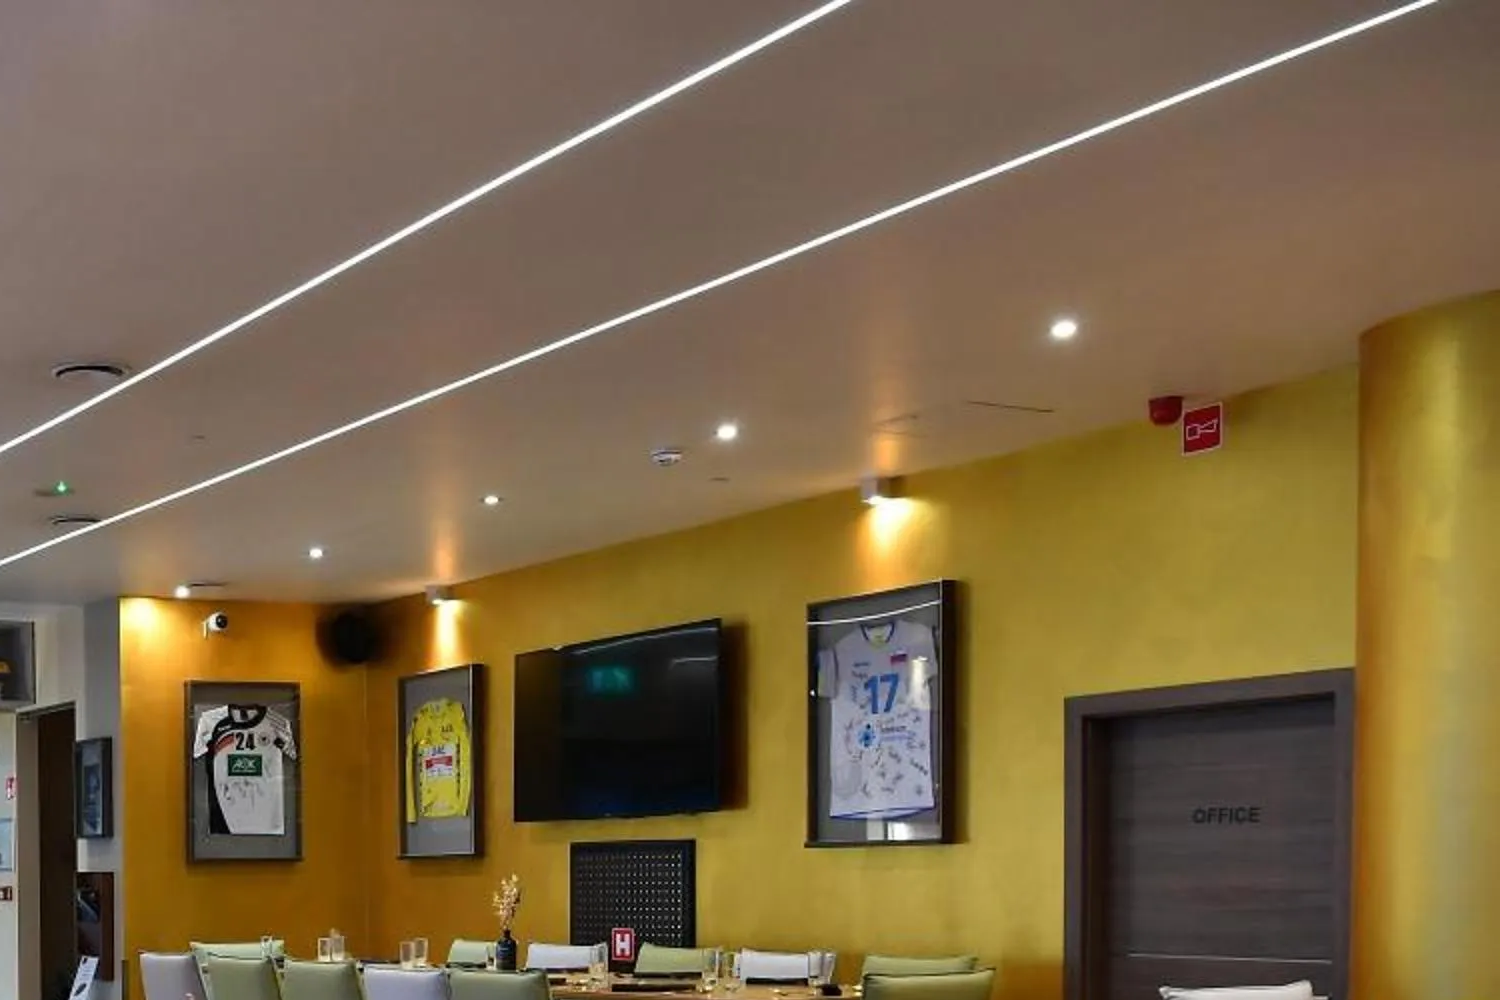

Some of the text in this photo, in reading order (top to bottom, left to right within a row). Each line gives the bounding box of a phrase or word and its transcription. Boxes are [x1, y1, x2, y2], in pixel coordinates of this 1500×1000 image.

[865, 674, 899, 714] 17
[235, 732, 256, 750] 24
[1192, 806, 1261, 824] OFFICE
